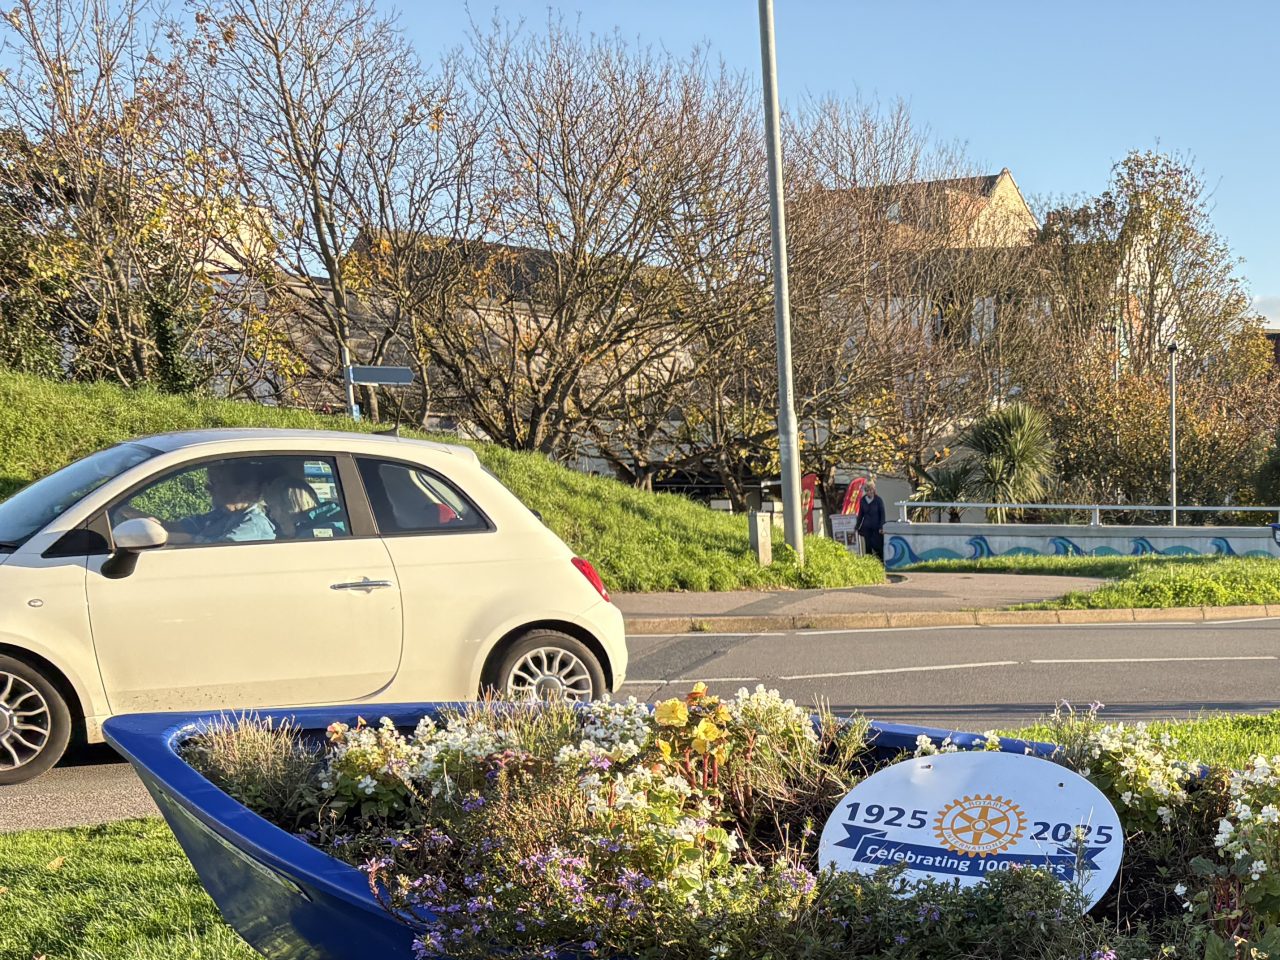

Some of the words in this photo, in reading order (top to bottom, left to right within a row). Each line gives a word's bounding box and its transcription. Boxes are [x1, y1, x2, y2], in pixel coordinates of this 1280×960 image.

[846, 802, 928, 829] 1925
[969, 800, 1003, 808] ROTARY
[945, 831, 1009, 851] INTERNATIONAL
[865, 845, 971, 872] Celebrating
[977, 859, 1010, 871] 100
[1021, 863, 1066, 874] ears
